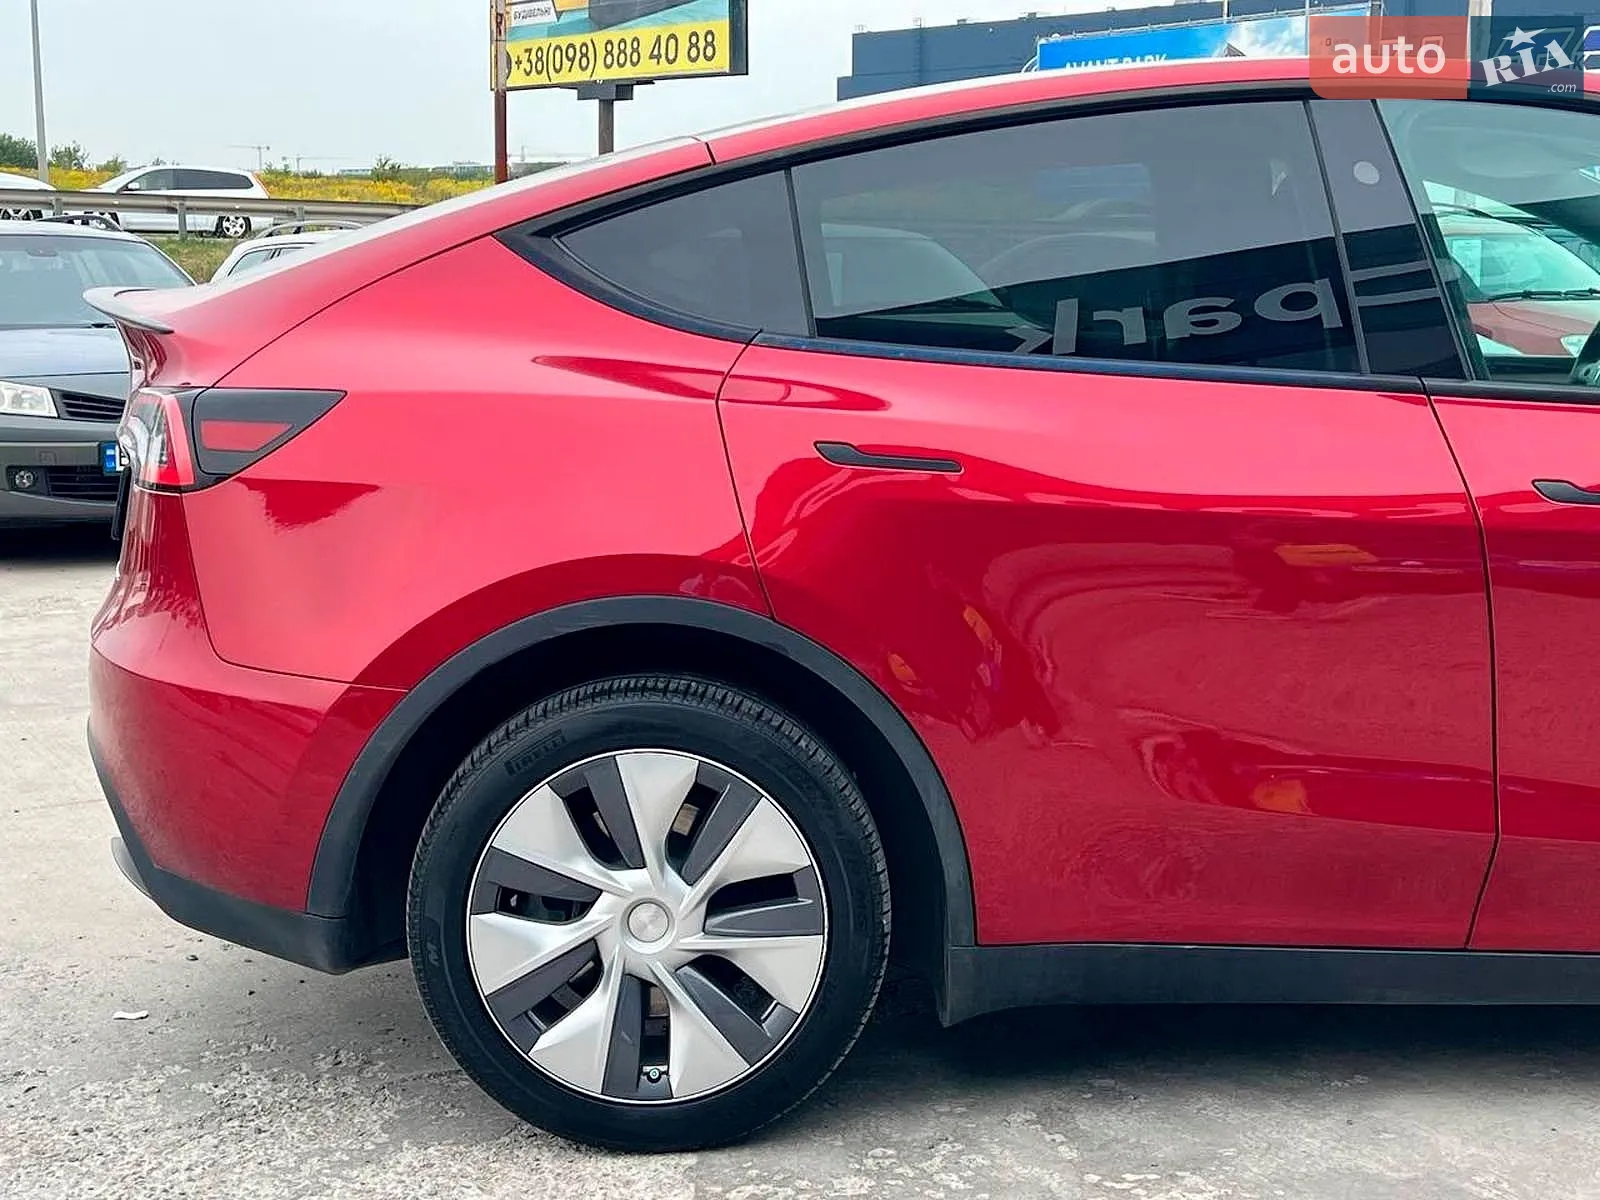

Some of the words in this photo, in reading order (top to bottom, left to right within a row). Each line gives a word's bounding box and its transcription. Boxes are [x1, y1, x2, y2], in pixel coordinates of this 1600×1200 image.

[515, 38, 597, 82] +38(098)
[604, 36, 641, 70] 888
[649, 33, 679, 65] 40
[687, 29, 717, 62] 88
